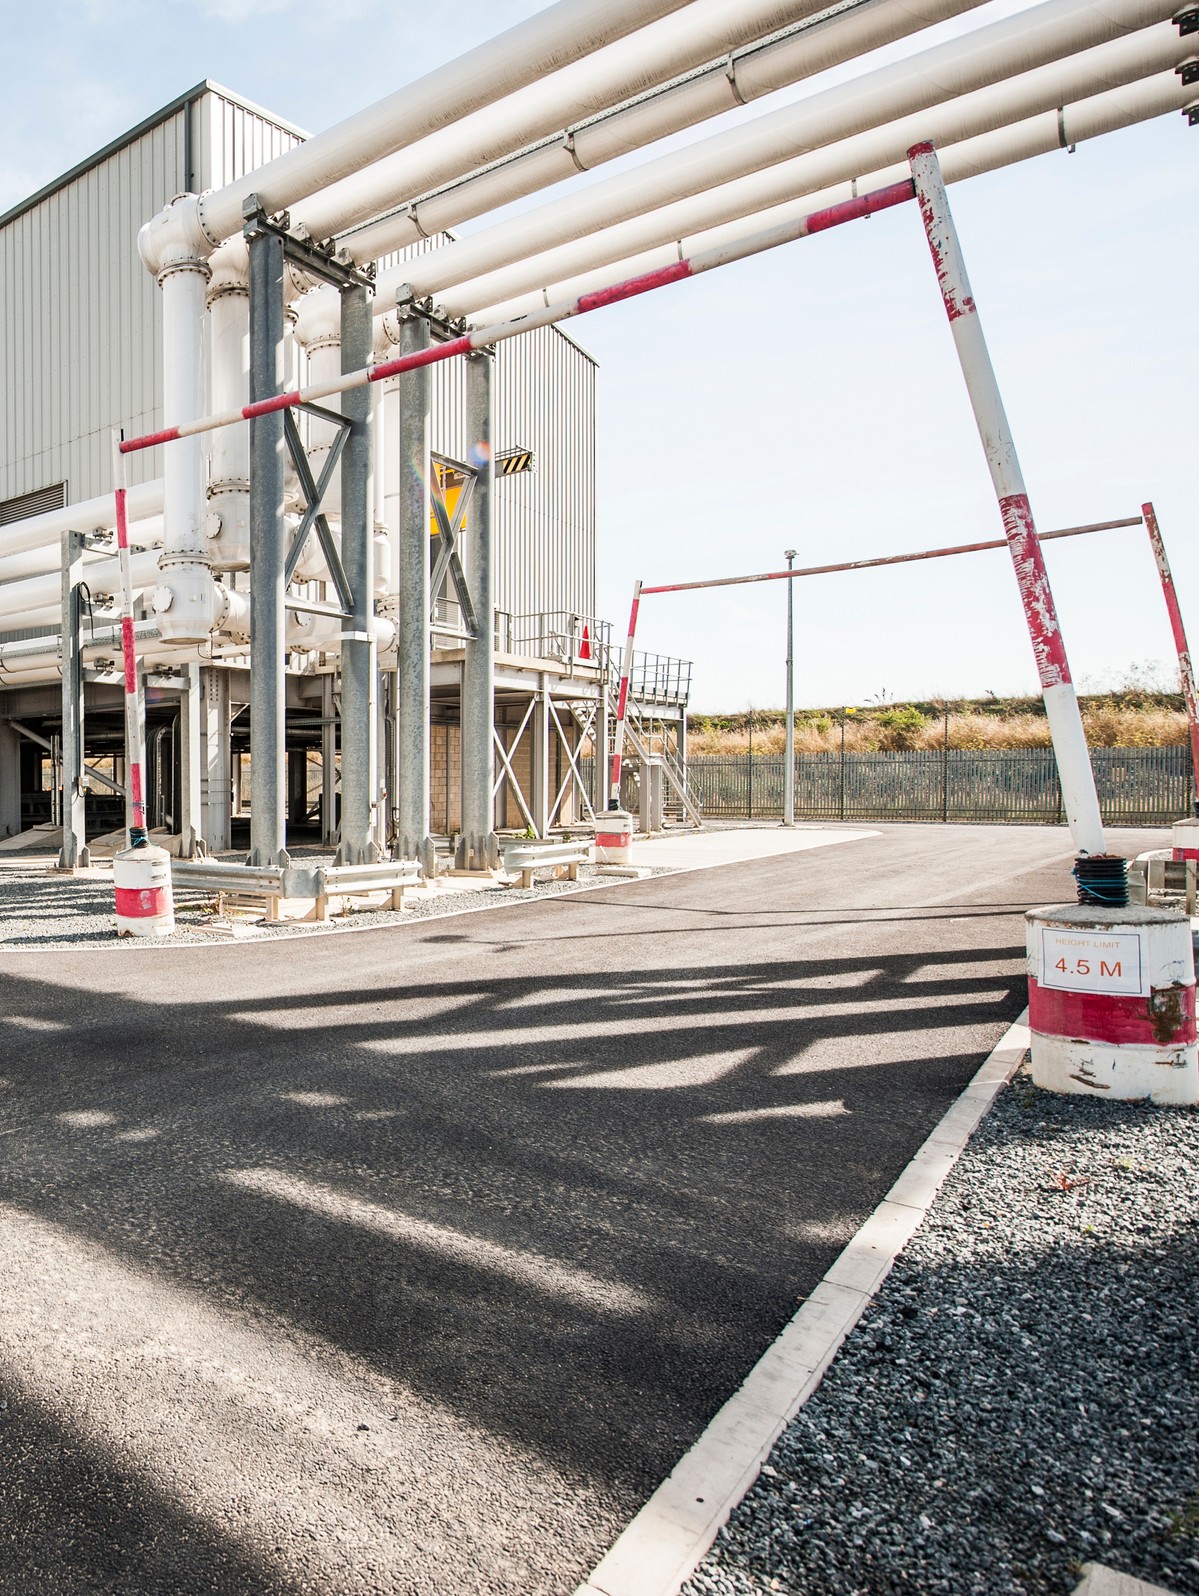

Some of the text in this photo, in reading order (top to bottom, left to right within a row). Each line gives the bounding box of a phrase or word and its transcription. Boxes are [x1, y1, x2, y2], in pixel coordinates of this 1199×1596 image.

[1056, 938, 1090, 947] HEIGHT
[1055, 957, 1122, 977] 4.5 M
